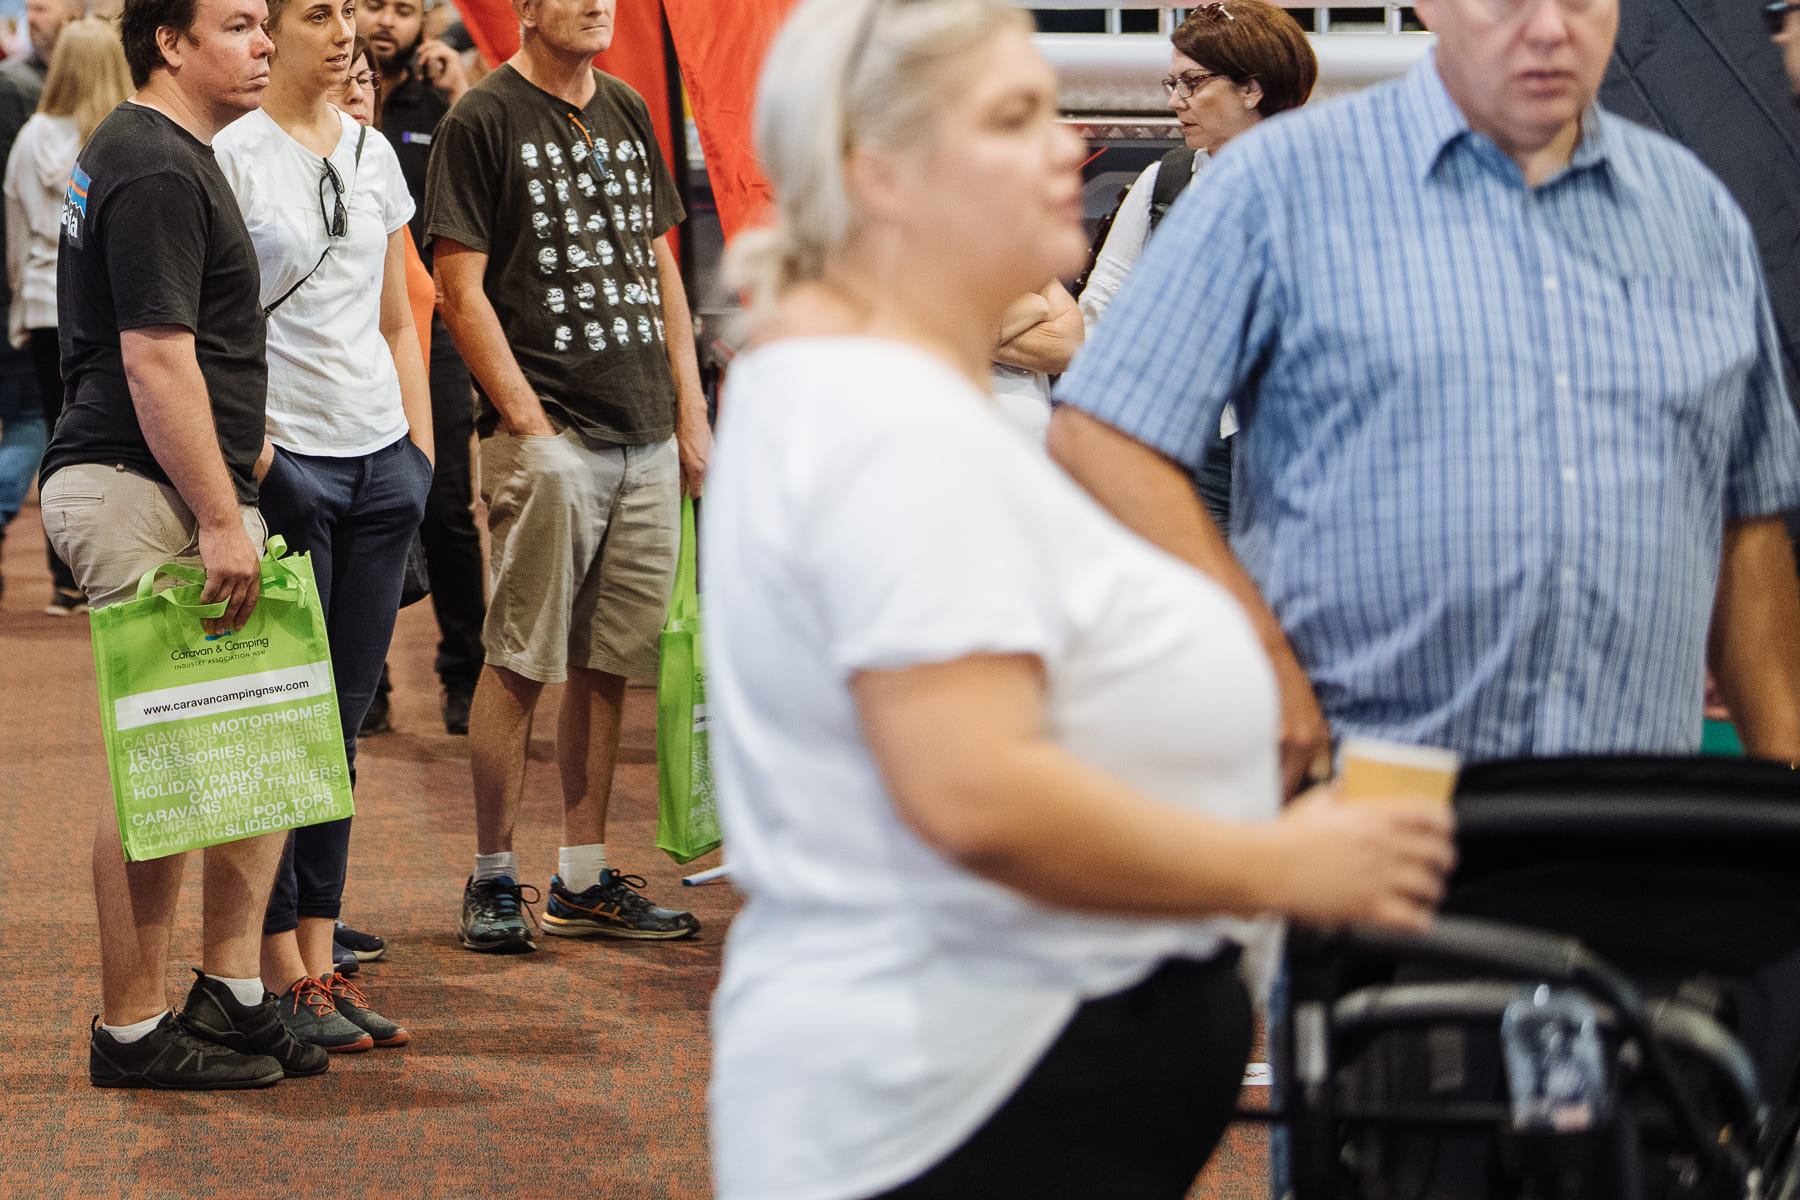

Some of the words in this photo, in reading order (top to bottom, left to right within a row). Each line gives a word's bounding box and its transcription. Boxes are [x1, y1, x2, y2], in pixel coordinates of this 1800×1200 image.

[171, 646, 213, 661] Caravan
[216, 644, 223, 653] &
[224, 637, 269, 651] Camping
[174, 660, 206, 670] INDUSTRY
[208, 652, 250, 664] ASSOCIATION
[252, 650, 266, 658] NSW
[143, 679, 309, 716] www.caravancampingnsw.com
[122, 724, 211, 750] CARAVANS
[212, 702, 331, 735] MOTORHOMES
[126, 742, 180, 762] TENTS
[184, 736, 217, 753] POP
[222, 727, 266, 745] TOPS
[270, 716, 329, 737] CABINS
[129, 743, 246, 775] ACCESSORIES
[248, 729, 332, 753] GLAMPING
[130, 757, 244, 787] CAMPERVANS
[247, 746, 307, 767] CABINS
[134, 777, 205, 800] HOLIDAY
[209, 767, 264, 788] PARKS
[268, 755, 328, 776] CABINS
[190, 781, 260, 803] CAMPER
[264, 765, 341, 790] TRAILERS
[132, 801, 221, 826] CARAVANS
[224, 779, 341, 809] MOTORHOMES
[137, 808, 251, 838] CAMPERVANS
[254, 801, 287, 818] POP
[291, 792, 333, 811] TOPS
[136, 826, 224, 851] GLAMPING
[225, 811, 305, 837] SLIDEONS
